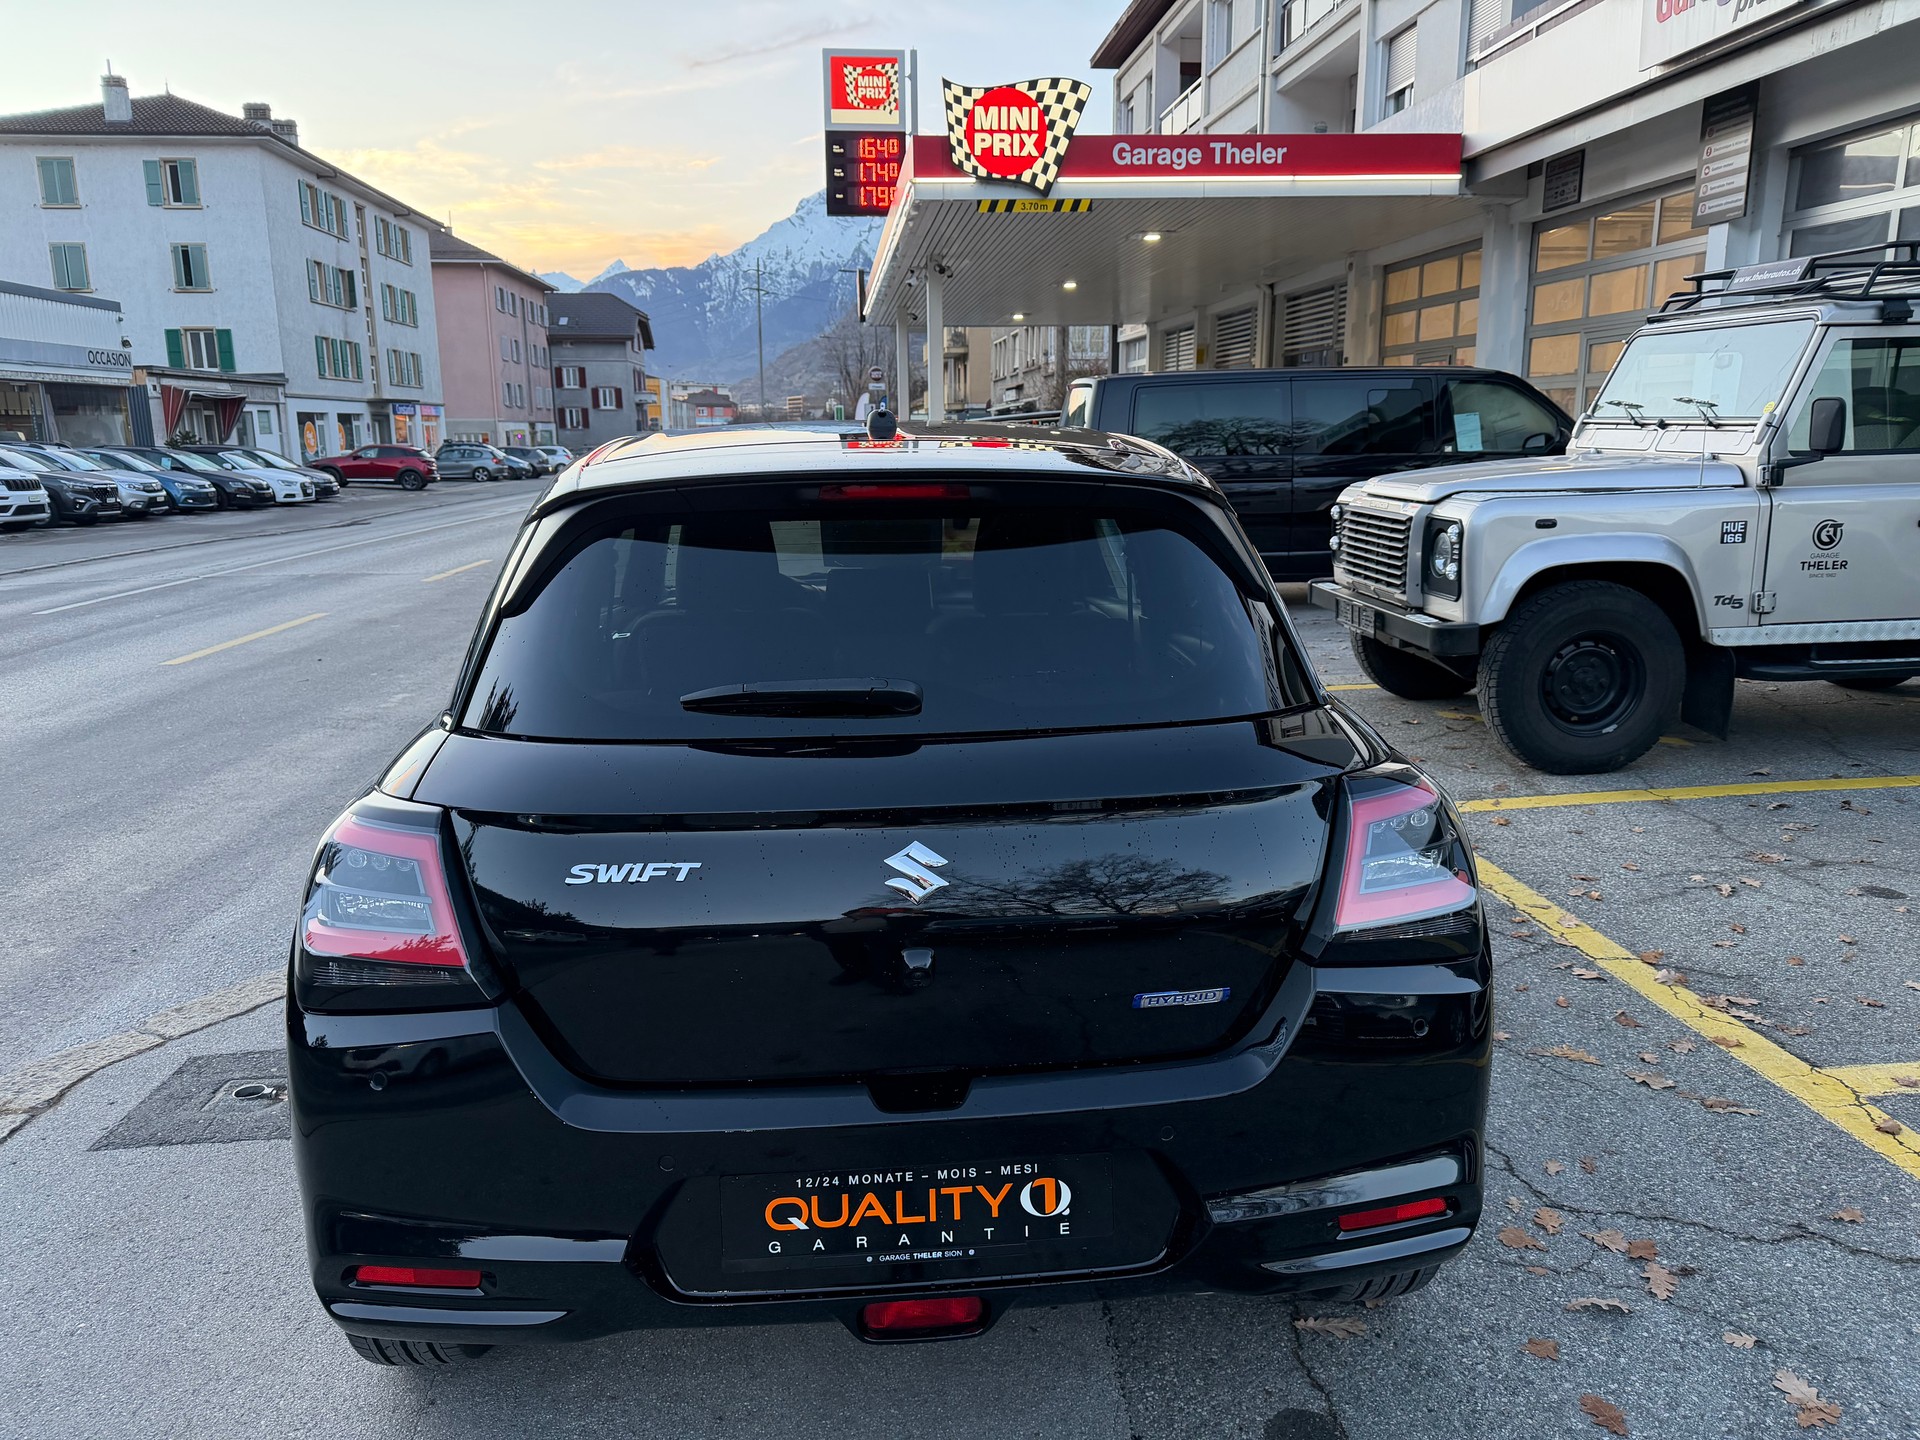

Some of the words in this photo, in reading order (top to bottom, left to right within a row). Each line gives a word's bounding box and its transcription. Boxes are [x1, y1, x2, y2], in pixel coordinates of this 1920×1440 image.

[857, 75, 887, 87] MINI
[857, 87, 888, 99] PRIX
[974, 105, 1039, 131] MINI
[974, 132, 1040, 157] PRIX
[1112, 142, 1203, 171] Garage
[1209, 142, 1288, 165] Theler
[1733, 265, 1801, 284] www.thelerautos.ch
[87, 350, 132, 367] OCCASION
[1723, 521, 1745, 533] HUE
[1800, 560, 1848, 571] THELER
[1714, 595, 1744, 609] Td5
[564, 862, 702, 885] SWIFT
[1147, 991, 1217, 1005] HYBRID
[796, 1176, 840, 1188] 12/24
[848, 1171, 914, 1185] MONATE
[937, 1167, 977, 1180] MOIS
[1000, 1163, 1038, 1176] MESI
[764, 1183, 1014, 1231] QUALITY
[768, 1222, 1070, 1253] GARANTIE
[879, 1253, 911, 1262] GARAGE
[912, 1251, 943, 1260] THELER
[944, 1250, 963, 1258] SION
